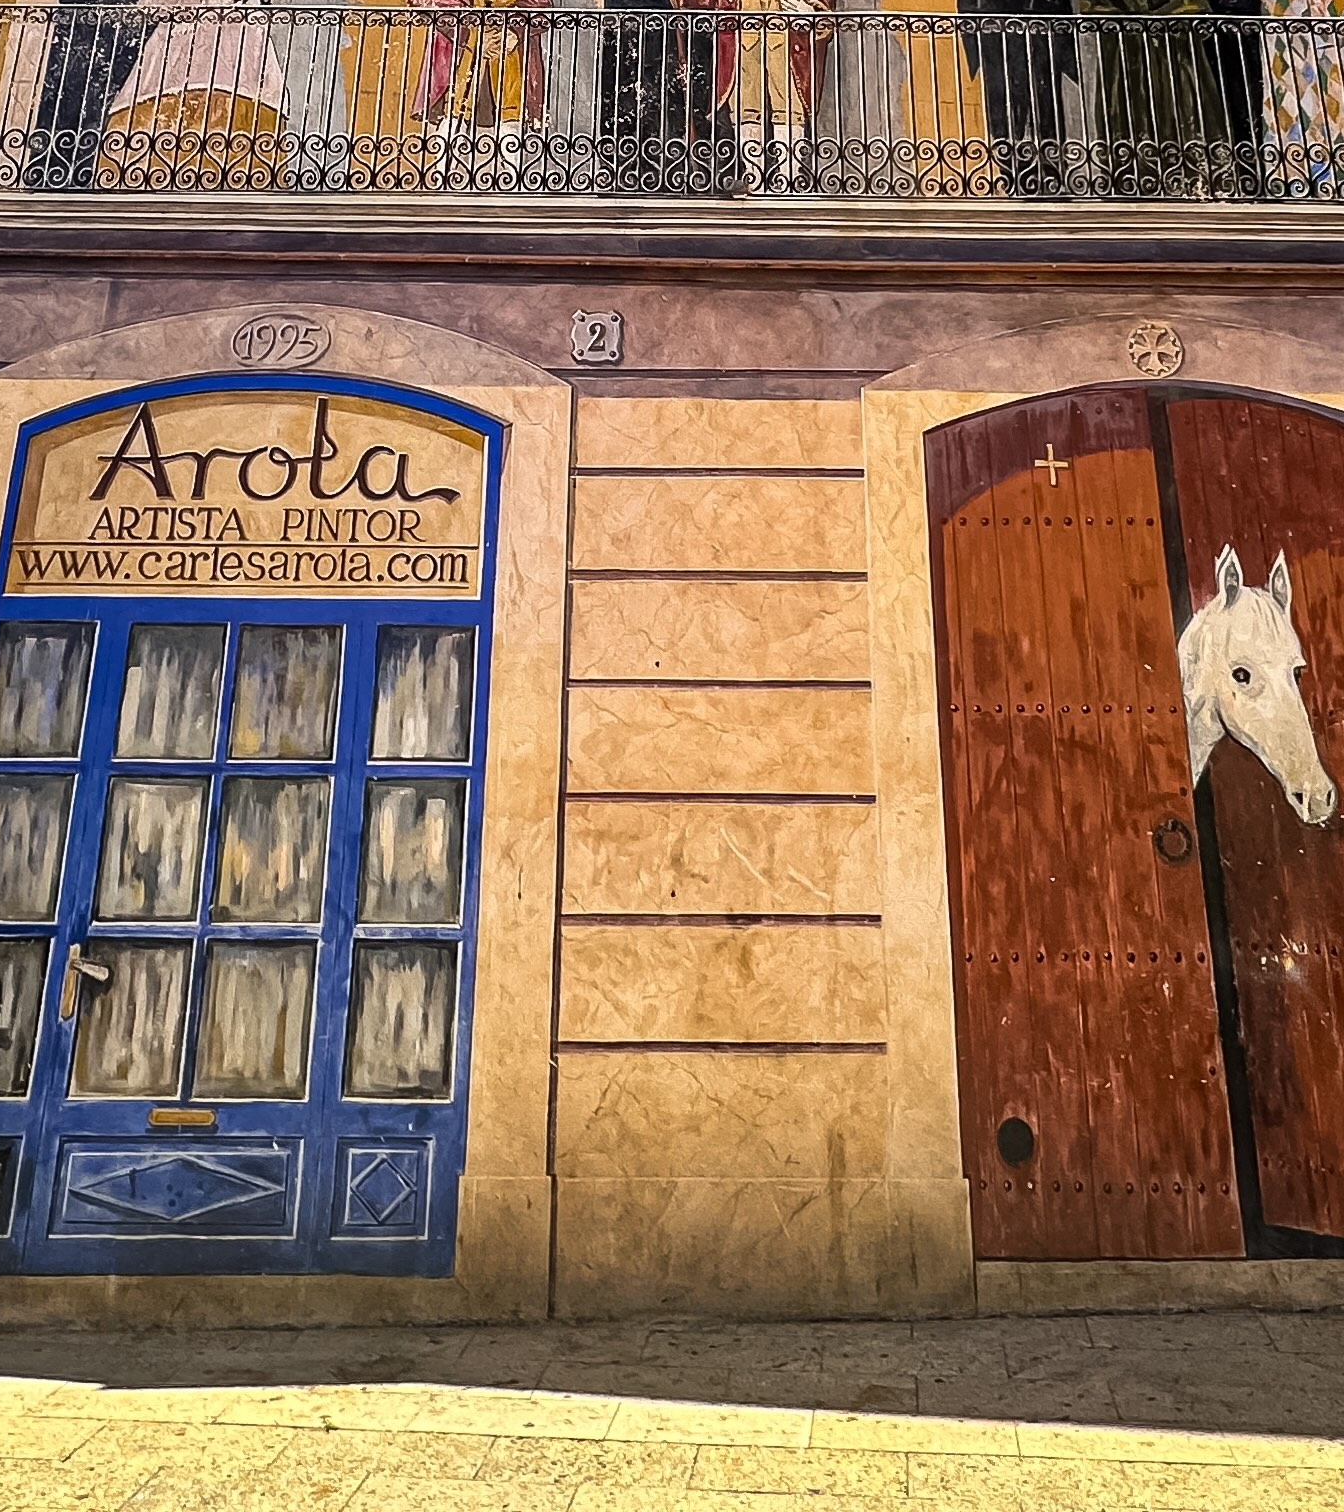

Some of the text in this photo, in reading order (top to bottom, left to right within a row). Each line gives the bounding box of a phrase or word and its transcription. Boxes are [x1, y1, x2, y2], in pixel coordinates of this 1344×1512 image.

[239, 324, 322, 361] 1995
[587, 322, 607, 352] 2
[88, 395, 461, 504] Arola
[88, 506, 425, 543] ARTISTA PINTOR
[15, 545, 469, 584] www.carlesarola.com
